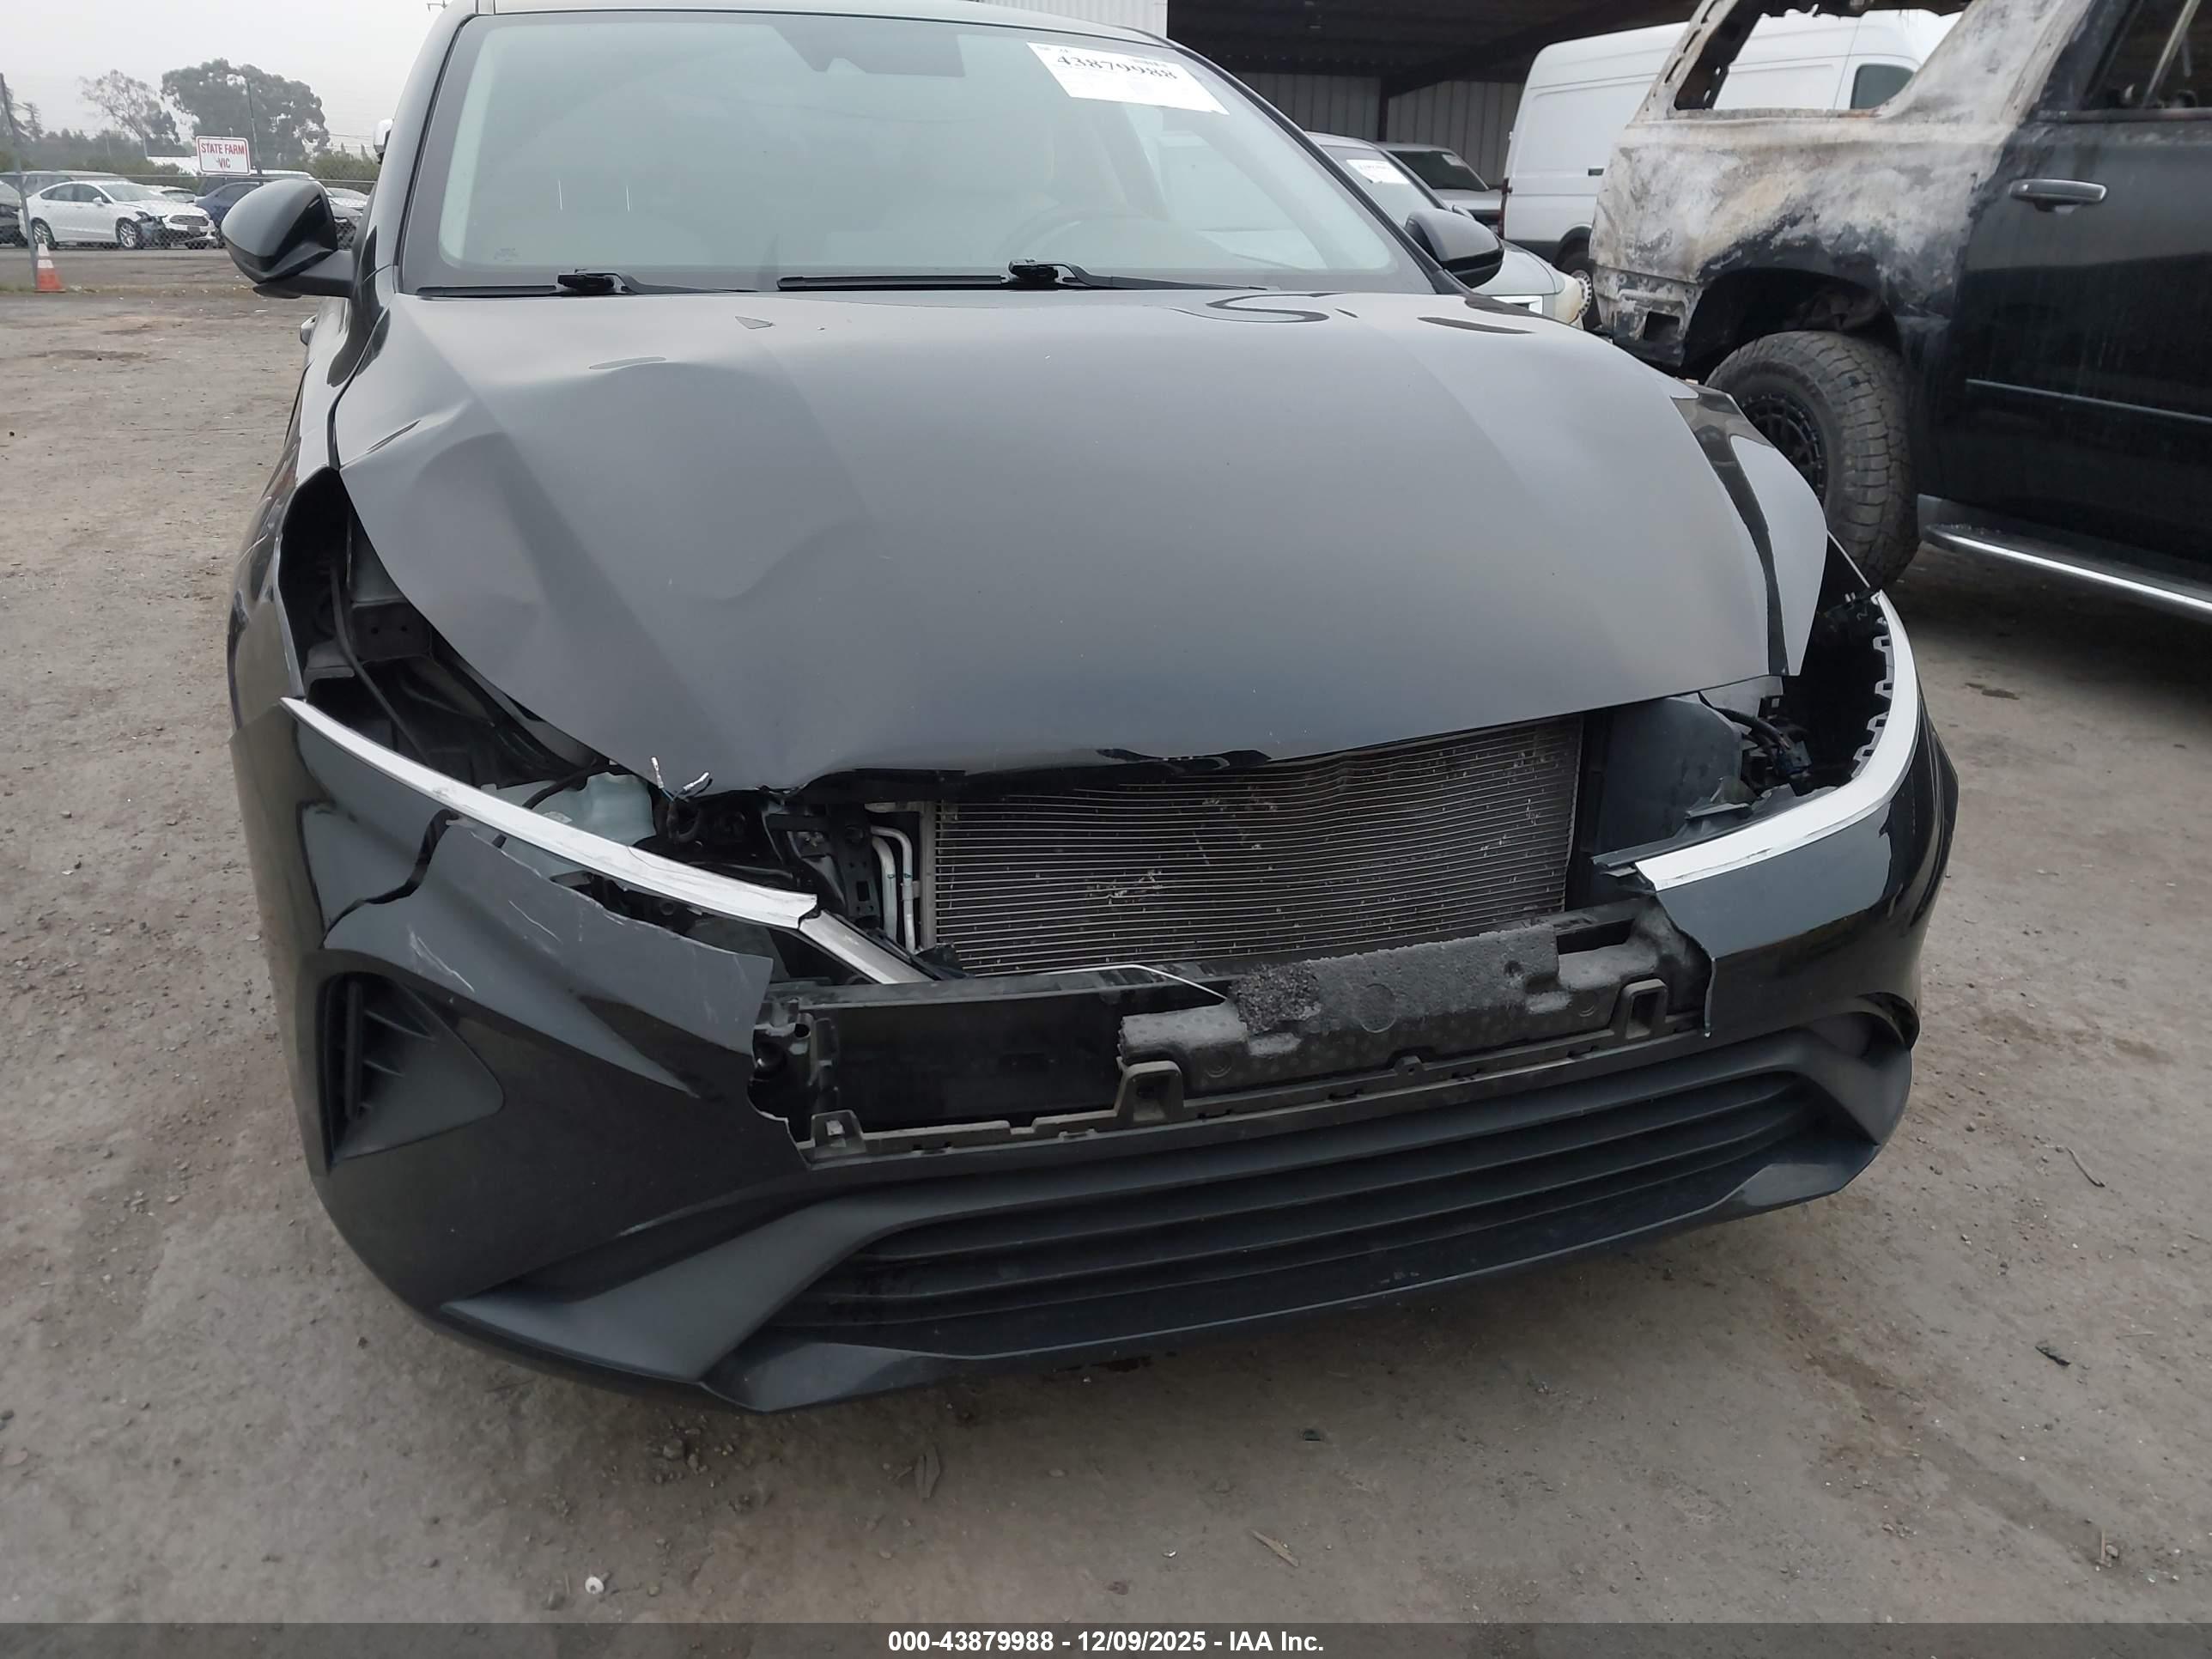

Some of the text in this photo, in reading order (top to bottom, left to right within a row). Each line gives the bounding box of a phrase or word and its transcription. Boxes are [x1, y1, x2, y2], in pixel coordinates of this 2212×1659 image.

[1057, 56, 1177, 79] 43879988
[201, 143, 245, 155] STATE FARM
[218, 157, 231, 168] VIC
